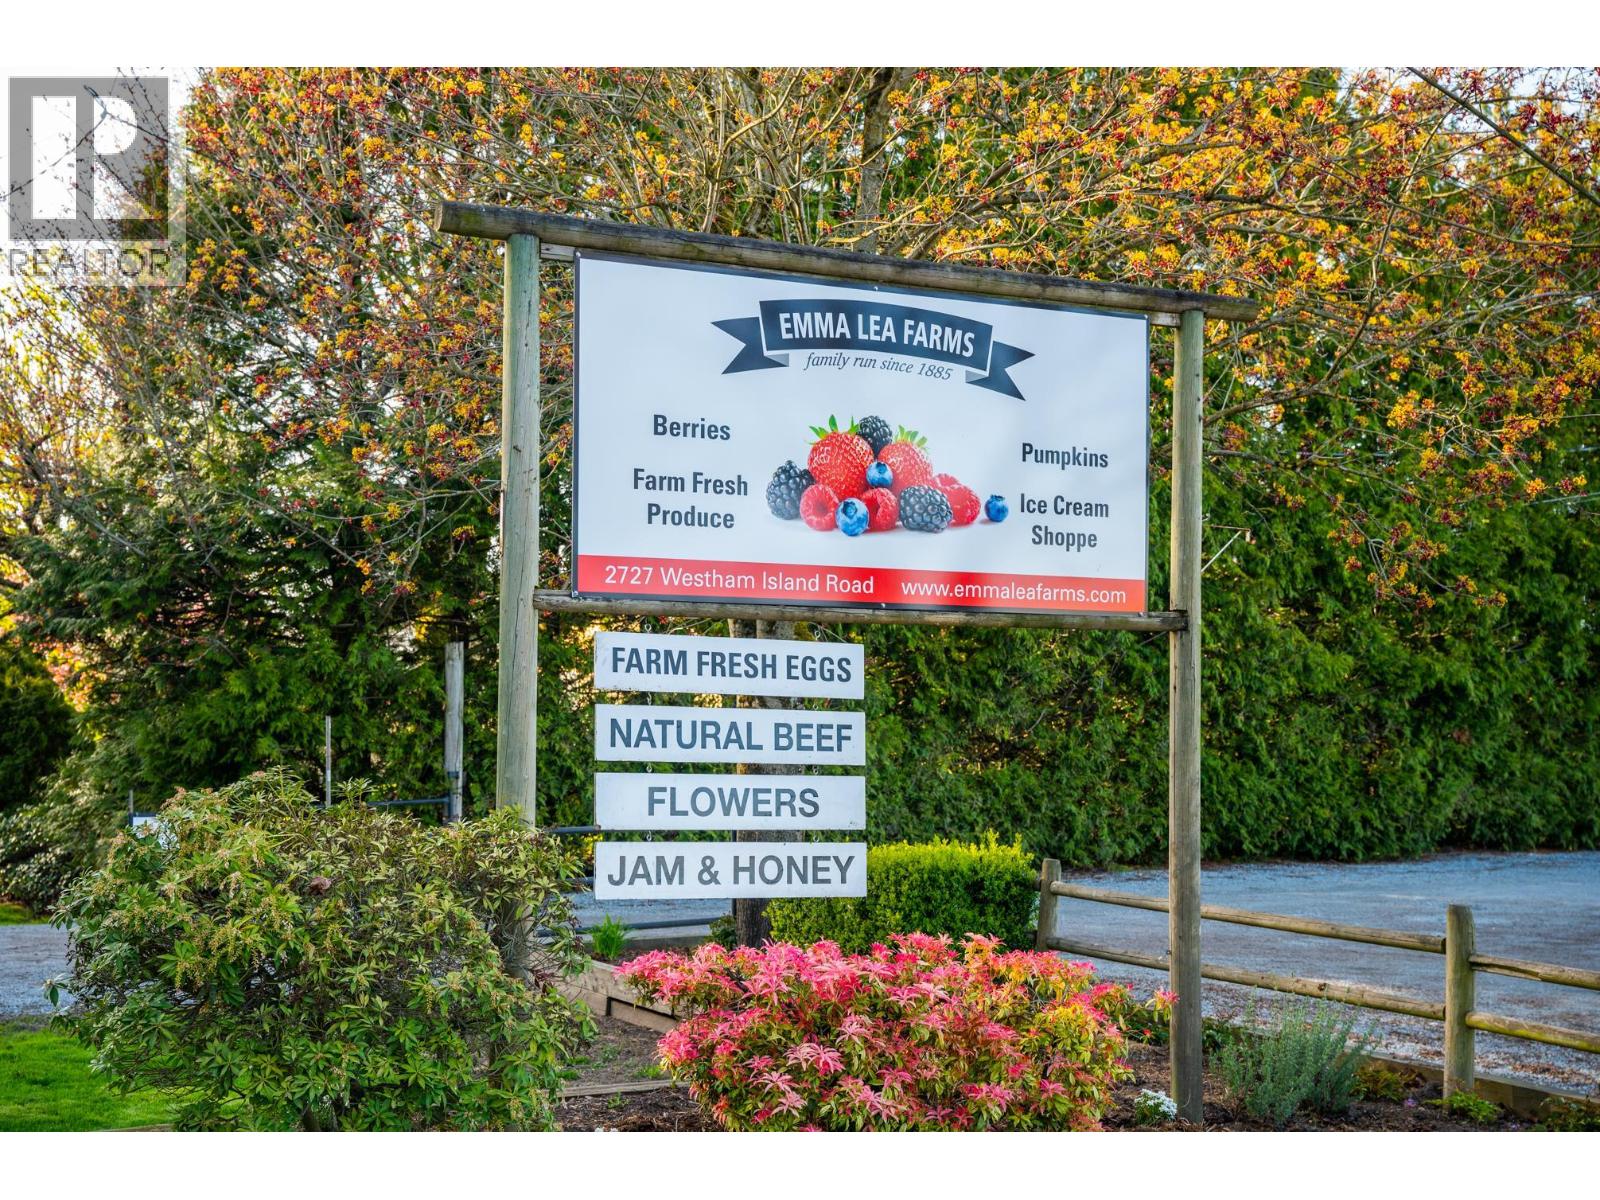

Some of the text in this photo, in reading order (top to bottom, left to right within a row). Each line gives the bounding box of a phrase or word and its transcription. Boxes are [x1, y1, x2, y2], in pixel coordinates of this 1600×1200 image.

[779, 312, 975, 357] EMMA LEA FARMS
[804, 352, 953, 380] family run since 1885
[653, 414, 730, 440] Berries
[1022, 442, 1108, 470] Pumpkins
[633, 468, 748, 496] Farm Fresh
[648, 503, 735, 528] Produce
[1021, 493, 1109, 517] Ice Cream
[1032, 525, 1097, 552] Shoppe
[605, 565, 874, 594] 2727 Westham Island Road
[901, 581, 1126, 603] www.emmaleafarms.com
[612, 647, 852, 682] FARM FRESH EGGS
[610, 718, 853, 752] NATURAL BEEF
[647, 786, 820, 817] FLOWERS
[607, 855, 855, 886] JAM & HONEY
